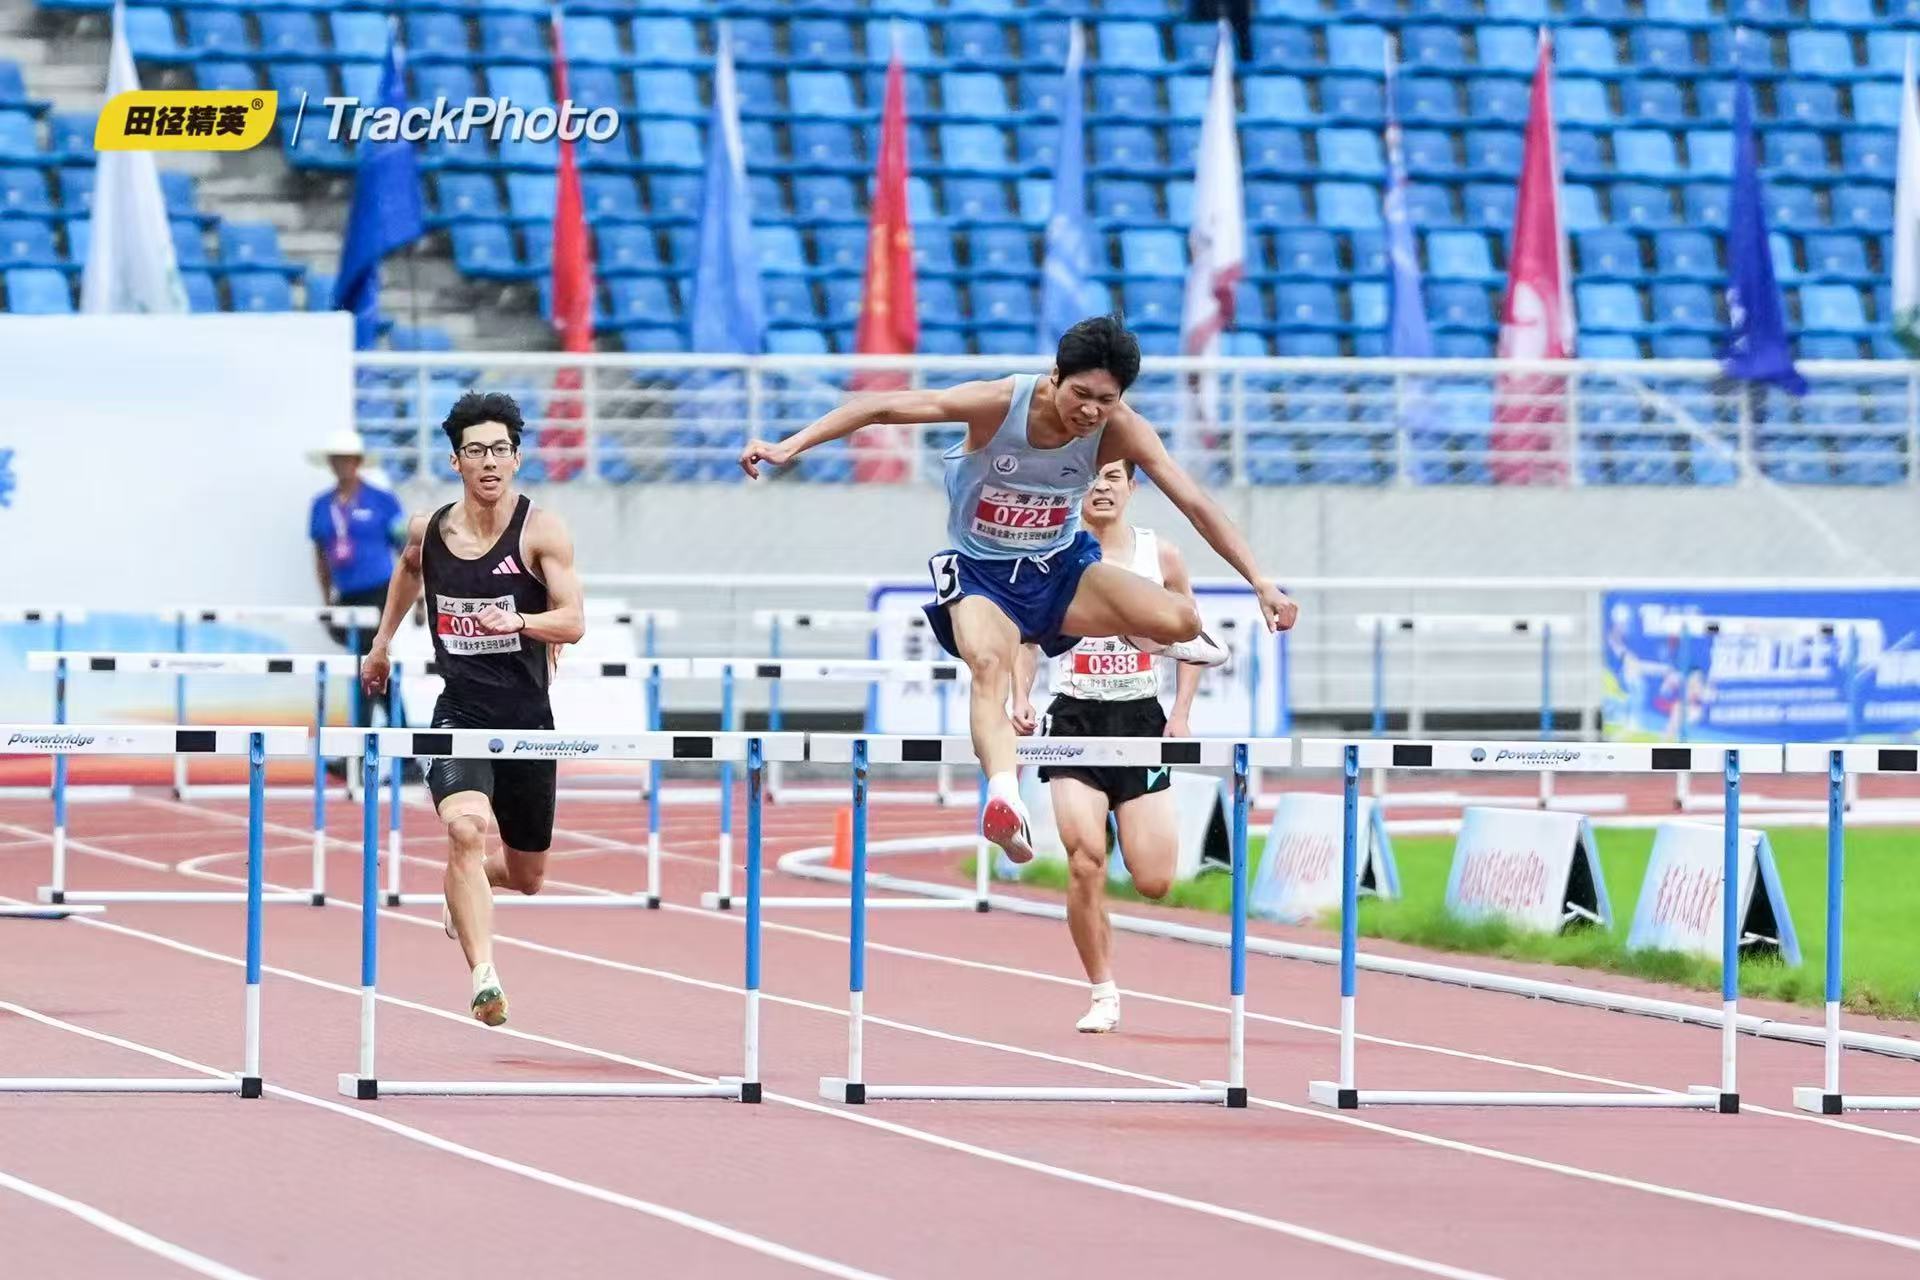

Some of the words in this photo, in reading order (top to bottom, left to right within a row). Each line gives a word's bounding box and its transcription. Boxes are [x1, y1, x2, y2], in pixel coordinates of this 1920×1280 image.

[1016, 493, 1067, 506] 海尔斯
[994, 506, 1051, 527] 0724
[1088, 654, 1138, 674] 0388
[8, 733, 95, 746] Powerbridge
[513, 739, 600, 753] Powerbridge
[1016, 745, 1084, 757] werbridge
[1495, 749, 1581, 762] Powerbridge
